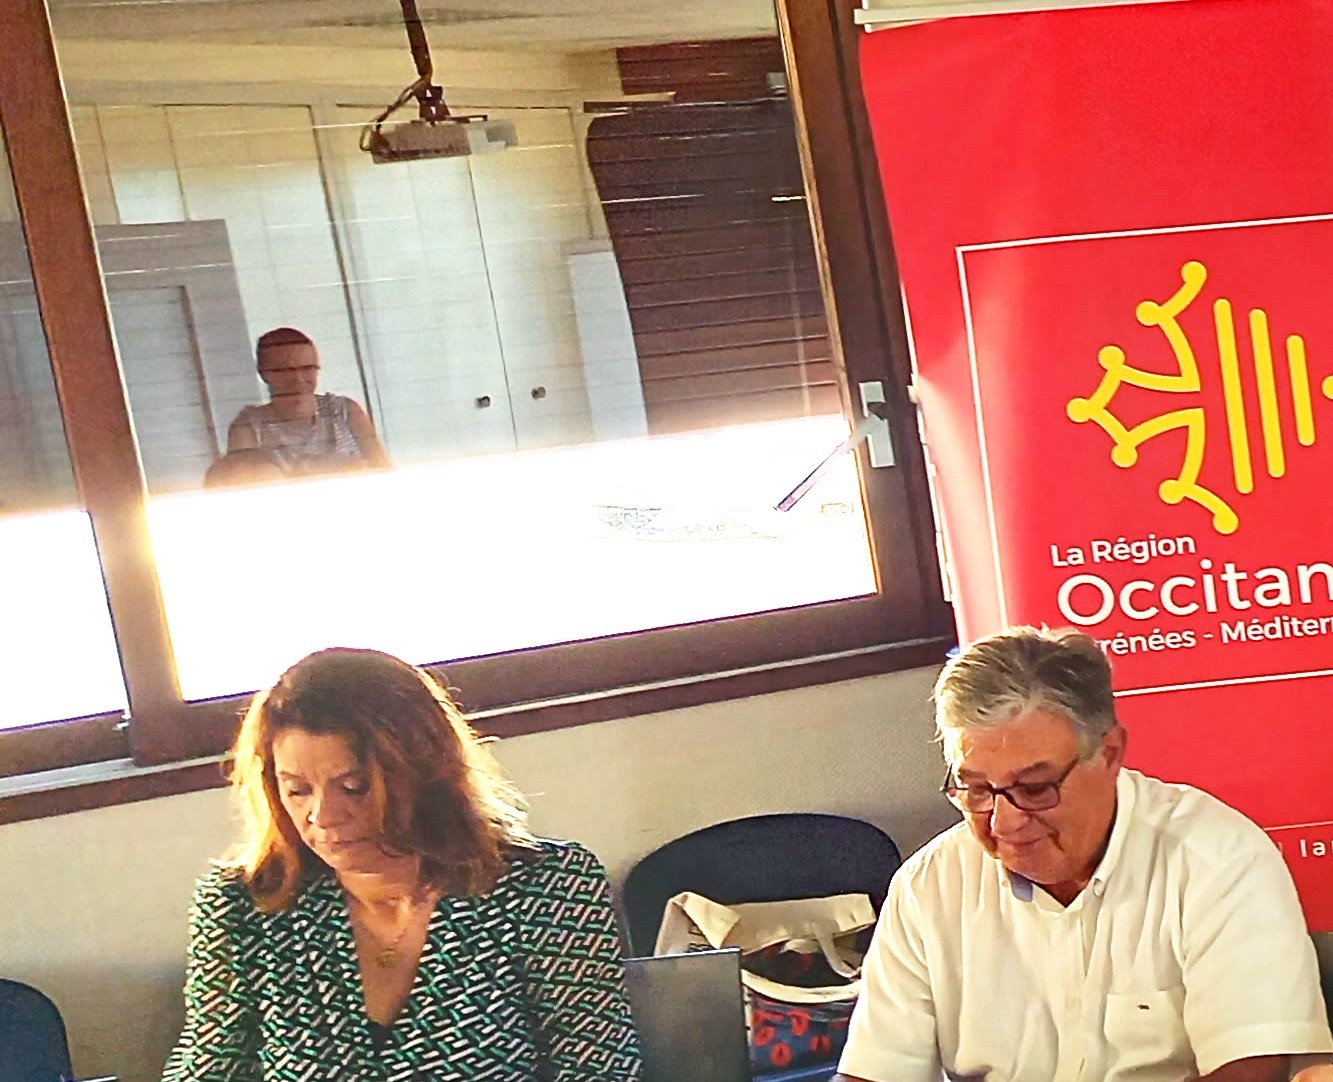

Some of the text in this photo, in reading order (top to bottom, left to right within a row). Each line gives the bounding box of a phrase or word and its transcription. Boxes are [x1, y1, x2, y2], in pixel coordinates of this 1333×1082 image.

[1050, 534, 1196, 567] La Région
[1095, 626, 1197, 656] rénées
